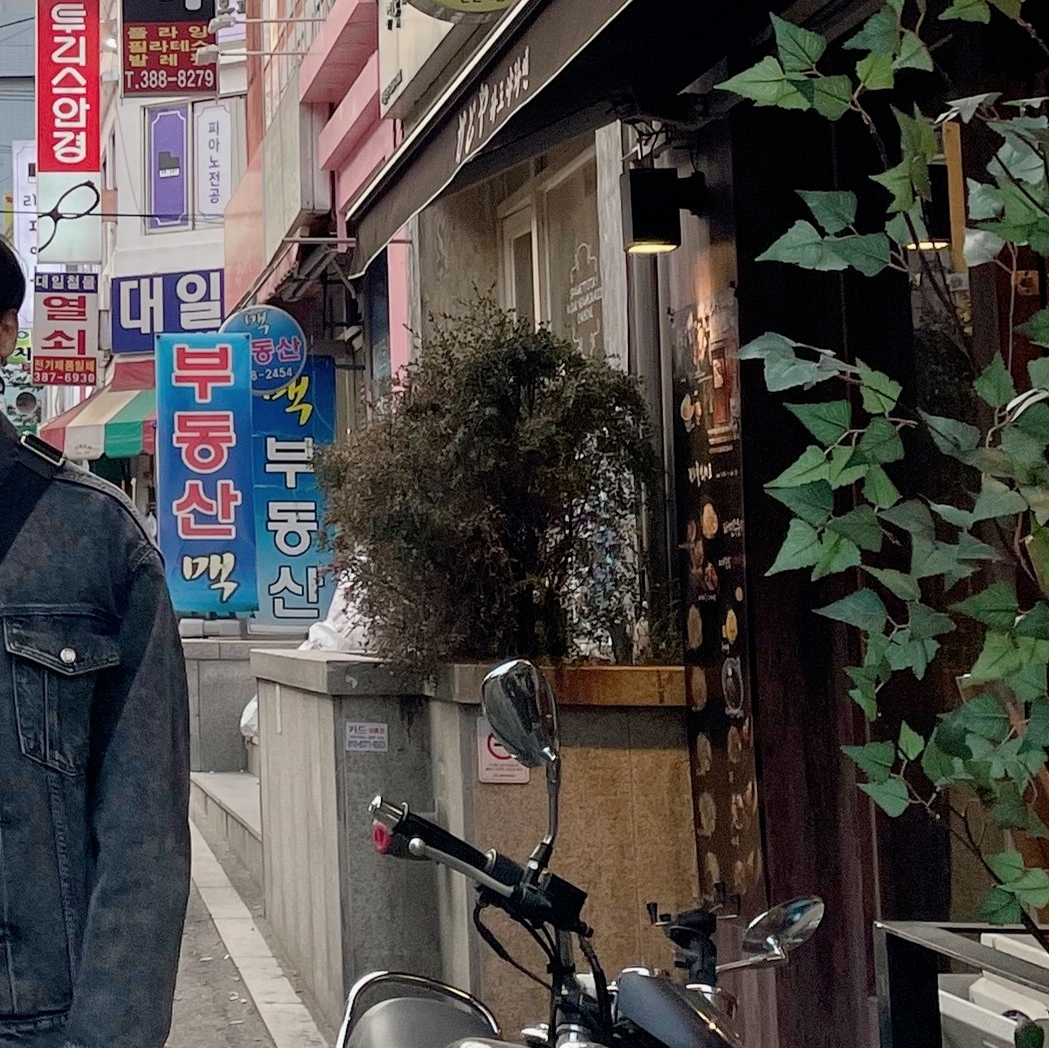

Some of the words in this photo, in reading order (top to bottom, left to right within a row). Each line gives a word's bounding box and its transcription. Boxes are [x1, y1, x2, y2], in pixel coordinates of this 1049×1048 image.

[124, 69, 214, 89] T.388-8279
[128, 53, 198, 67] 발레
[40, 295, 88, 356] 열쇠
[119, 271, 222, 335] 대일
[251, 336, 303, 366] 동산
[172, 343, 242, 540] 부동산
[264, 435, 324, 619] 부동산
